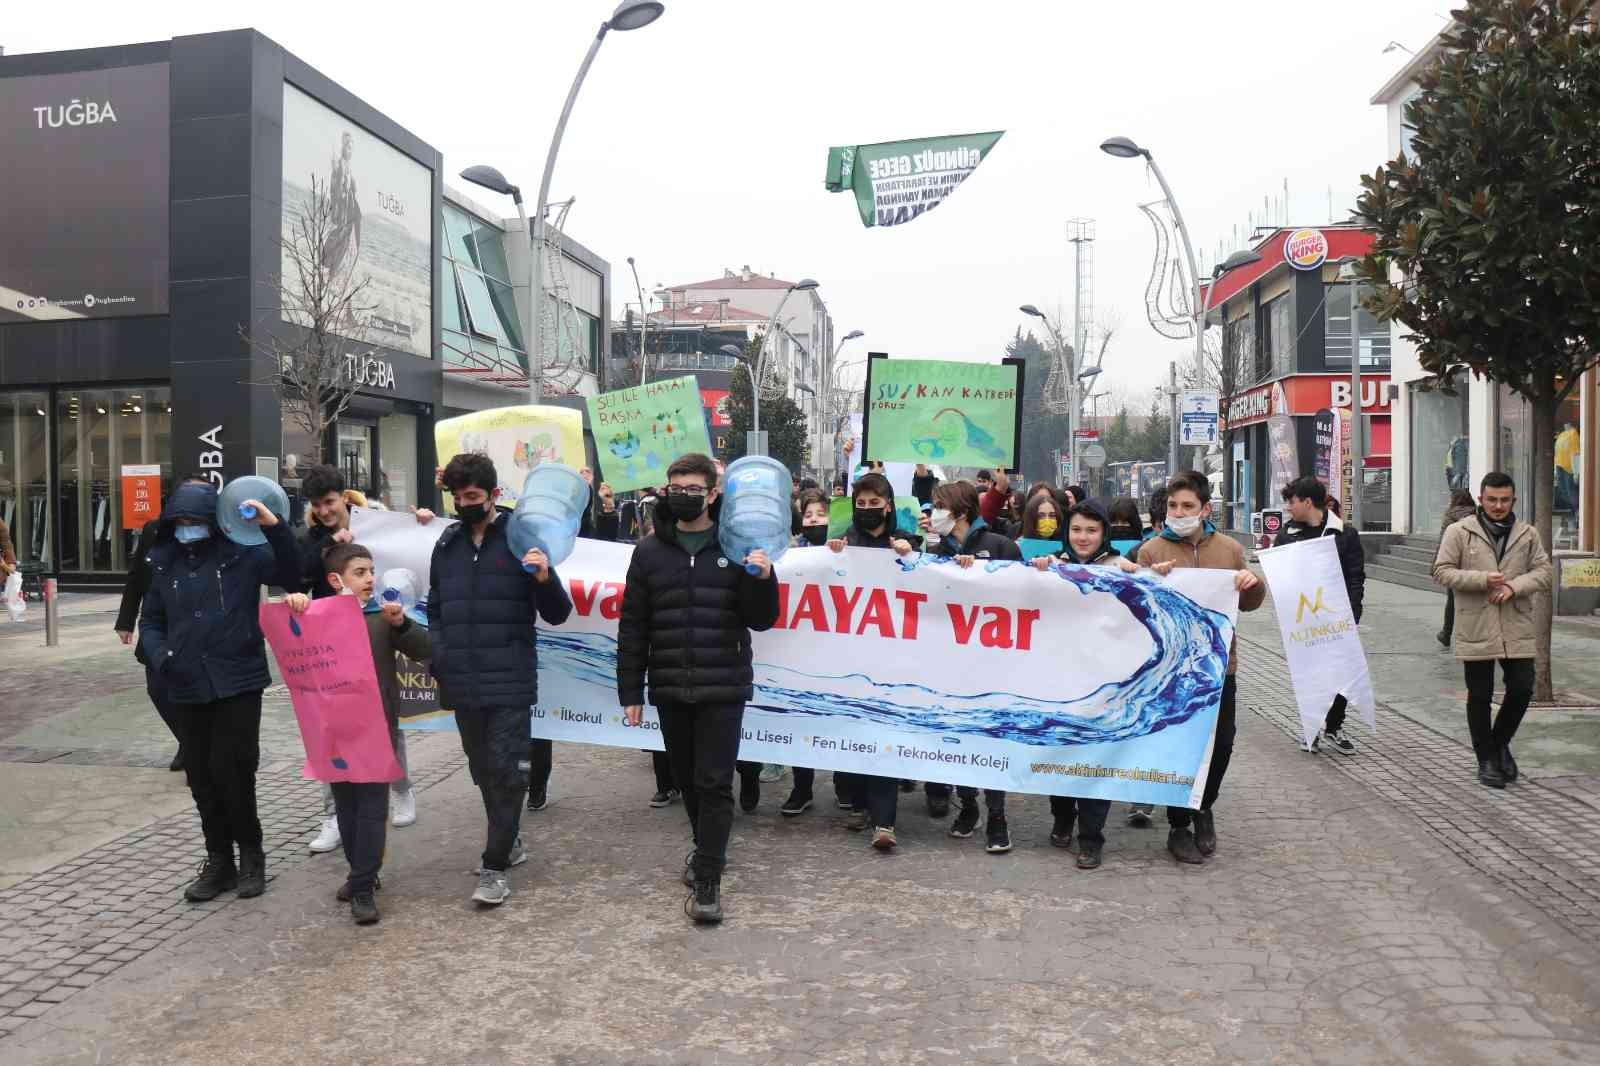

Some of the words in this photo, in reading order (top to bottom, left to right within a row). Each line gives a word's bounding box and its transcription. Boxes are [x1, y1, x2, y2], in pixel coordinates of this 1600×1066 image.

[33, 99, 118, 129] TUĞBA
[1292, 243, 1324, 261] KING
[569, 579, 628, 620] va
[946, 603, 1040, 651] var
[560, 706, 603, 725] İlkokul
[757, 728, 793, 745] Lisesi
[812, 735, 837, 751] Fen
[841, 739, 877, 754] Lisesi
[896, 745, 967, 765] Teknokent
[971, 753, 1009, 770] Koleji
